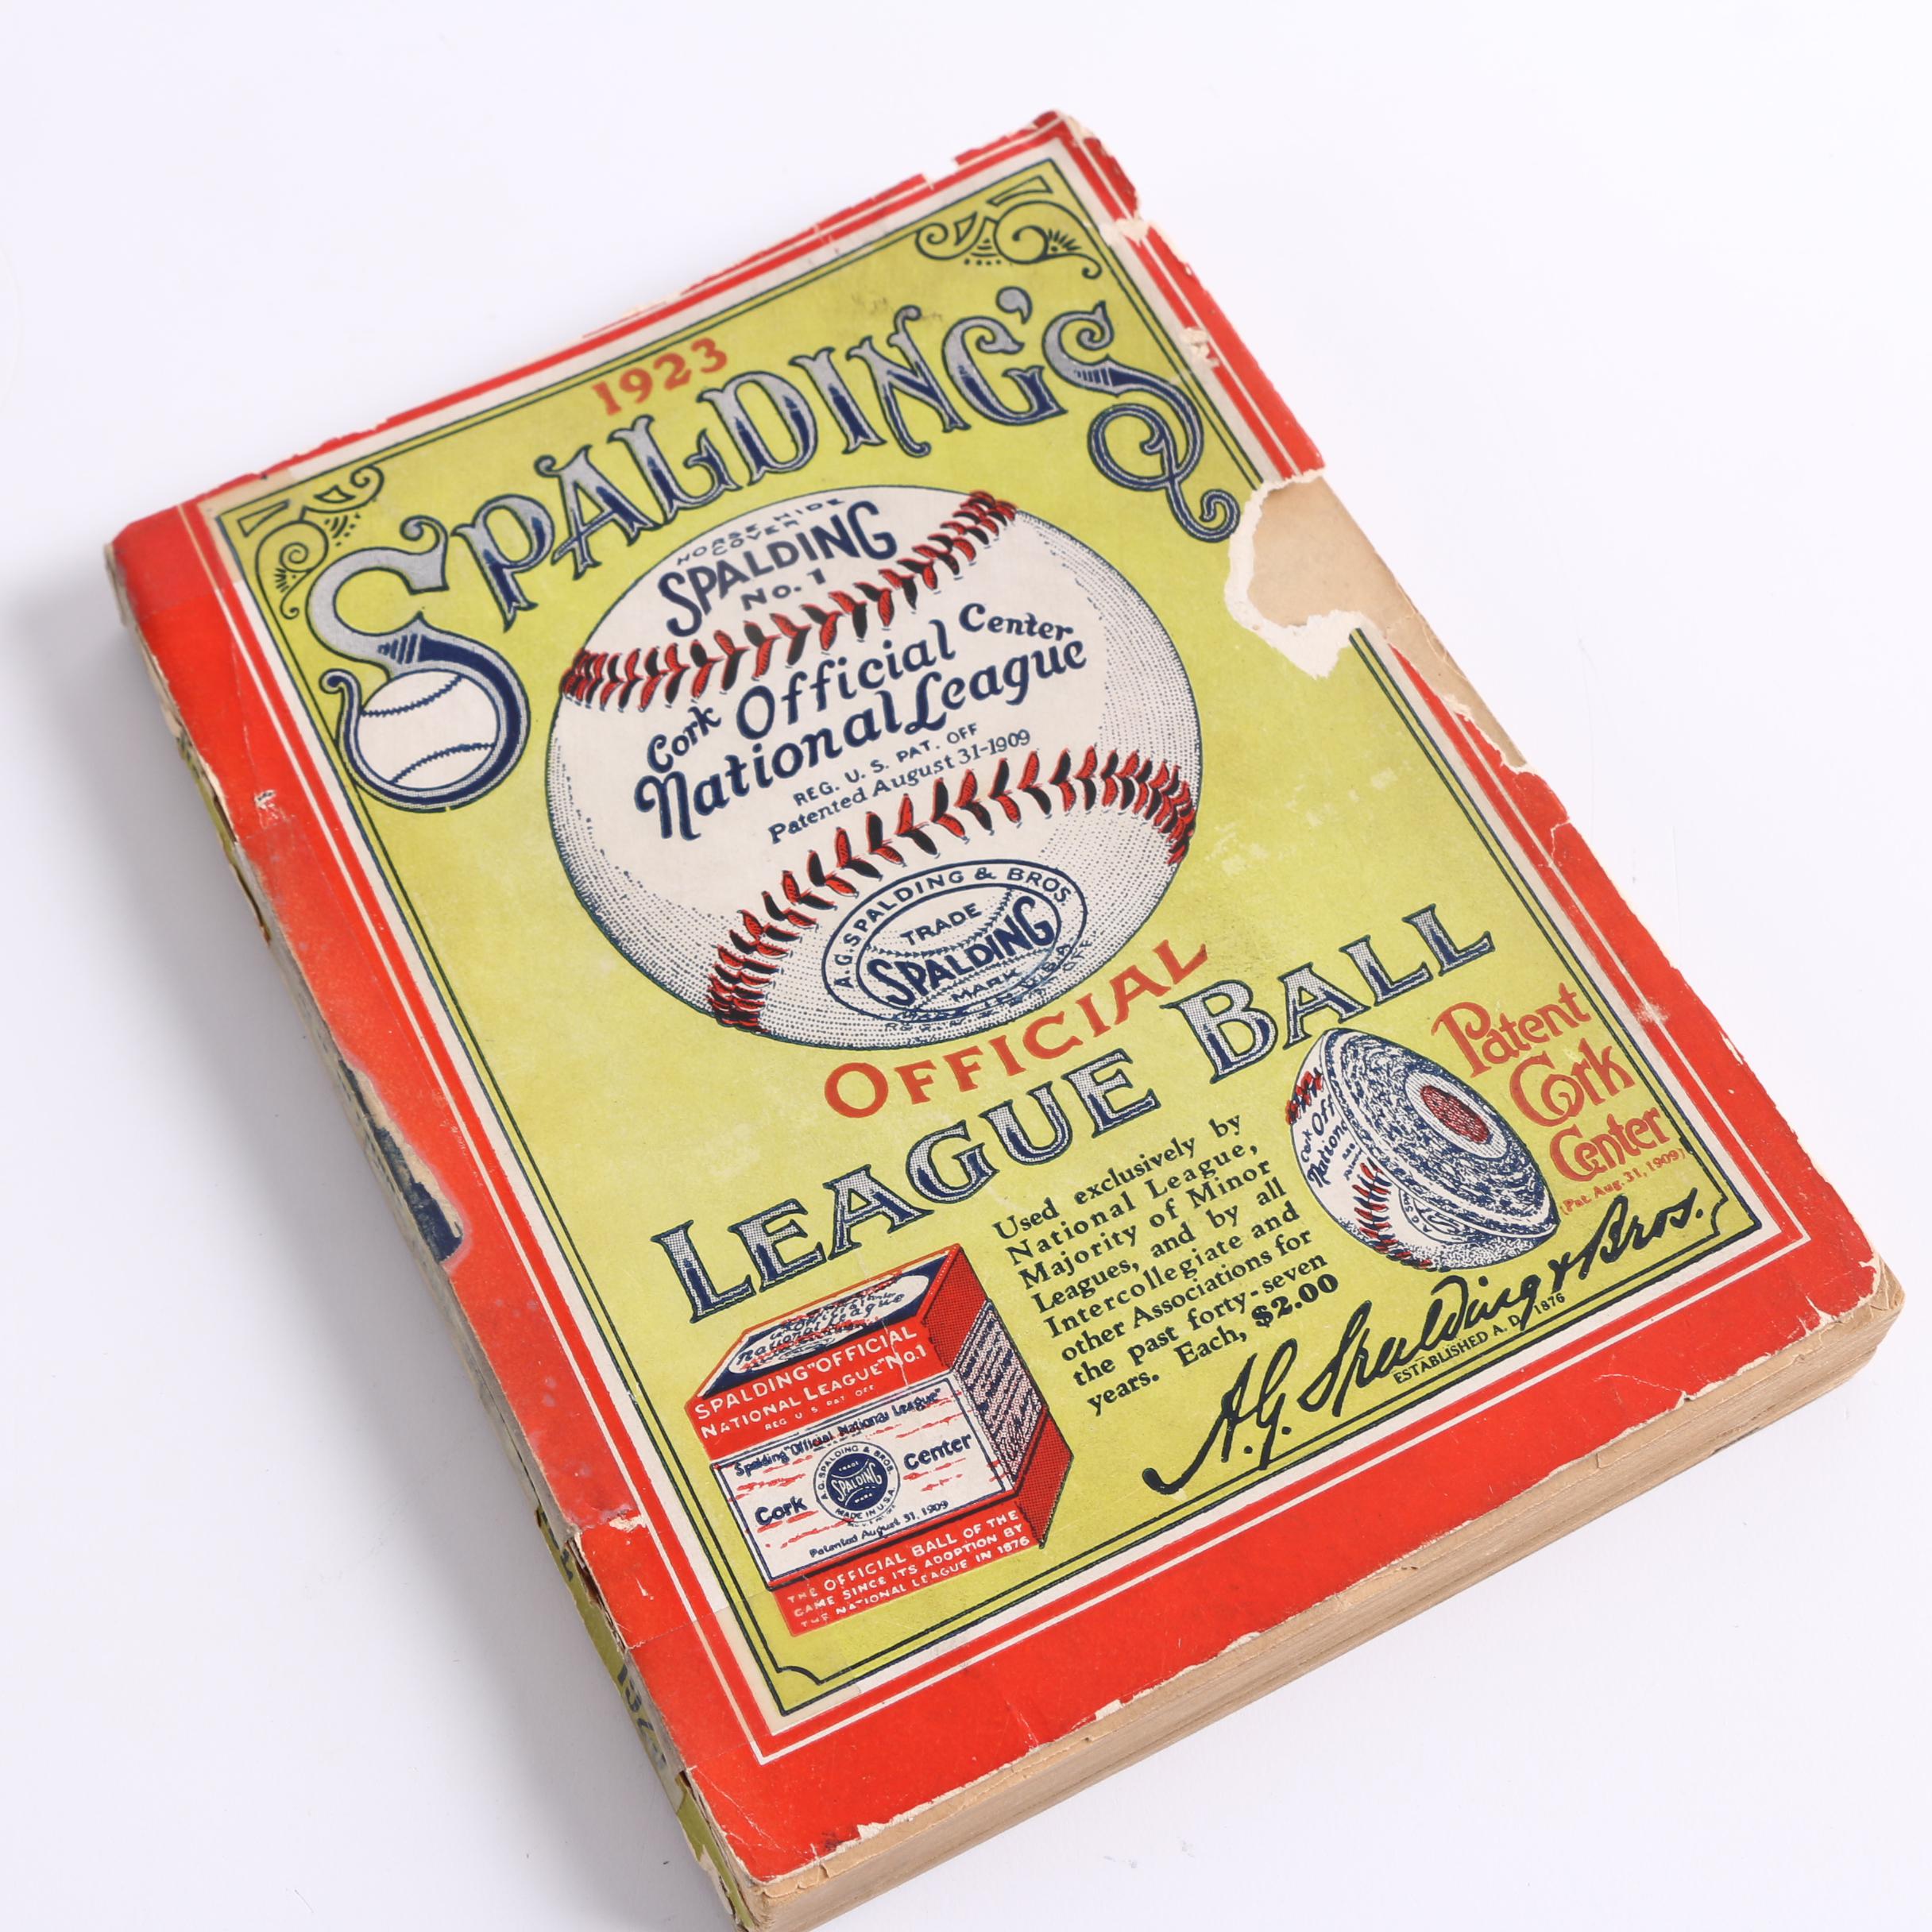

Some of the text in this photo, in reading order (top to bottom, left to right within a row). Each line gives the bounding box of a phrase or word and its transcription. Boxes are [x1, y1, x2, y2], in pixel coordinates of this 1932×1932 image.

[592, 337, 727, 416] 1923
[306, 286, 1239, 813] SPALDING'S
[658, 500, 898, 637] SPALDING
[677, 498, 845, 566] HORSE HIDE
[713, 519, 799, 556] COVER
[806, 568, 826, 585] 1
[959, 602, 1074, 642] Center
[736, 618, 956, 740] Official
[634, 639, 1087, 840] National League
[647, 706, 722, 774] Cork
[794, 782, 840, 808] REG.
[896, 740, 941, 763] PAT.
[947, 723, 979, 746] OFF
[767, 729, 1031, 844] Patented August 31-1909
[974, 866, 994, 880] &
[867, 895, 1056, 1007] SPALDING
[901, 902, 983, 947] TRADE
[825, 939, 1209, 1119] OFFICIAL
[952, 968, 1023, 1003] MARK
[1432, 982, 1591, 1080] Patent
[651, 903, 1496, 1324] LEAGUE BALL
[1509, 1037, 1636, 1128] Cork
[992, 1115, 1243, 1241] Used exclusively by
[1550, 1106, 1671, 1183] Center
[1005, 1142, 1259, 1266] National League,
[1017, 1160, 1272, 1290] Majority of Minor
[1030, 1177, 1288, 1315] Leagues, and by all
[1043, 1200, 1301, 1339] Intercollegiate and
[1061, 1227, 1313, 1362] other Associations for
[1296, 1273, 1542, 1420] Spalding
[1577, 1187, 1706, 1281] Bros.
[1072, 1252, 1329, 1387] the past forty-seven
[1088, 1273, 1340, 1417] years. Each, $2.00
[1393, 1331, 1490, 1385] ESTABLISHED
[1532, 1292, 1566, 1315] 1876
[695, 1362, 808, 1420] SPALDING
[701, 1393, 802, 1439] NATIONAL
[734, 1450, 790, 1478] Spalding
[838, 1411, 890, 1438] National
[830, 1462, 883, 1502] SPALDING
[903, 1432, 973, 1471] Center
[754, 1496, 808, 1525] Cork
[787, 1509, 1019, 1604] THE OFFICIAL BALL OF THE
[835, 1508, 863, 1520] MADE
[860, 1518, 902, 1540] August
[921, 1500, 949, 1517] 1909
[801, 1535, 1031, 1629] THE NATIONAL LEAGUE IN 1876
[843, 1576, 887, 1601] SINCE
[891, 1563, 918, 1580] ITS
[924, 1535, 998, 1567] ADOPTION
[1003, 1524, 1024, 1538] BY
